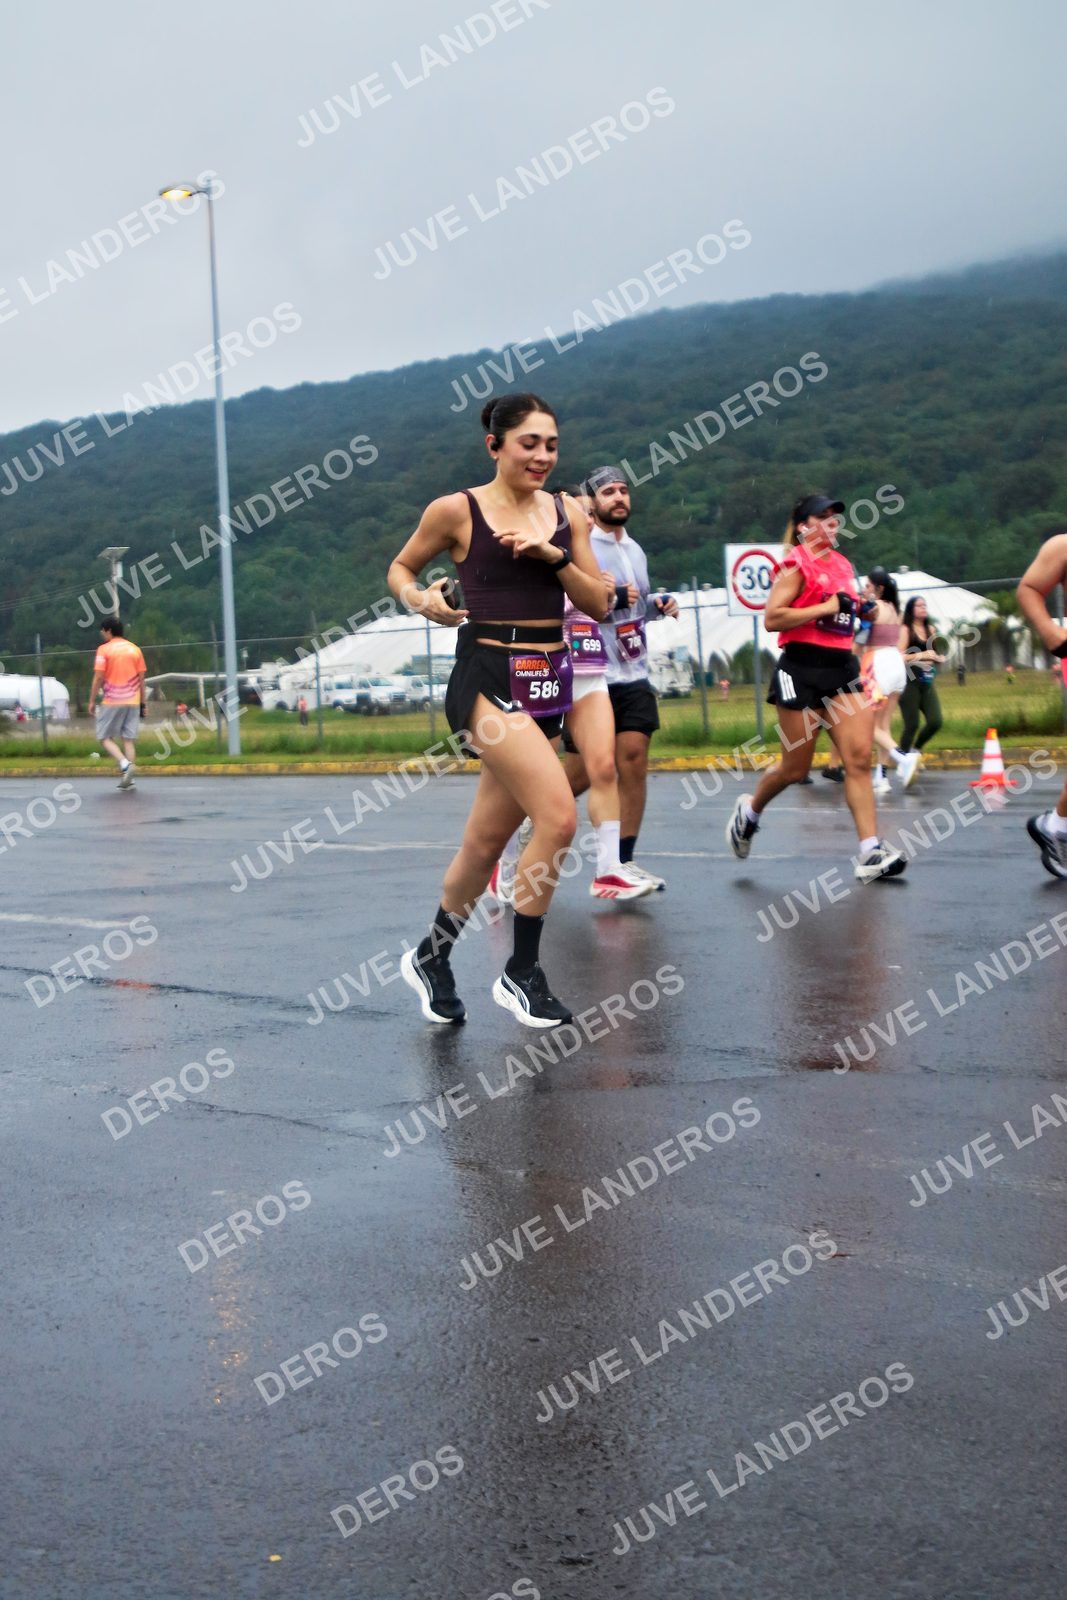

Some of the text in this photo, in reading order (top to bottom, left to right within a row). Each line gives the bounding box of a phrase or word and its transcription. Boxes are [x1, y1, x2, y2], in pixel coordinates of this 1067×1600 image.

[740, 565, 773, 590] 30
[582, 638, 602, 652] 699
[529, 680, 560, 699] 586
